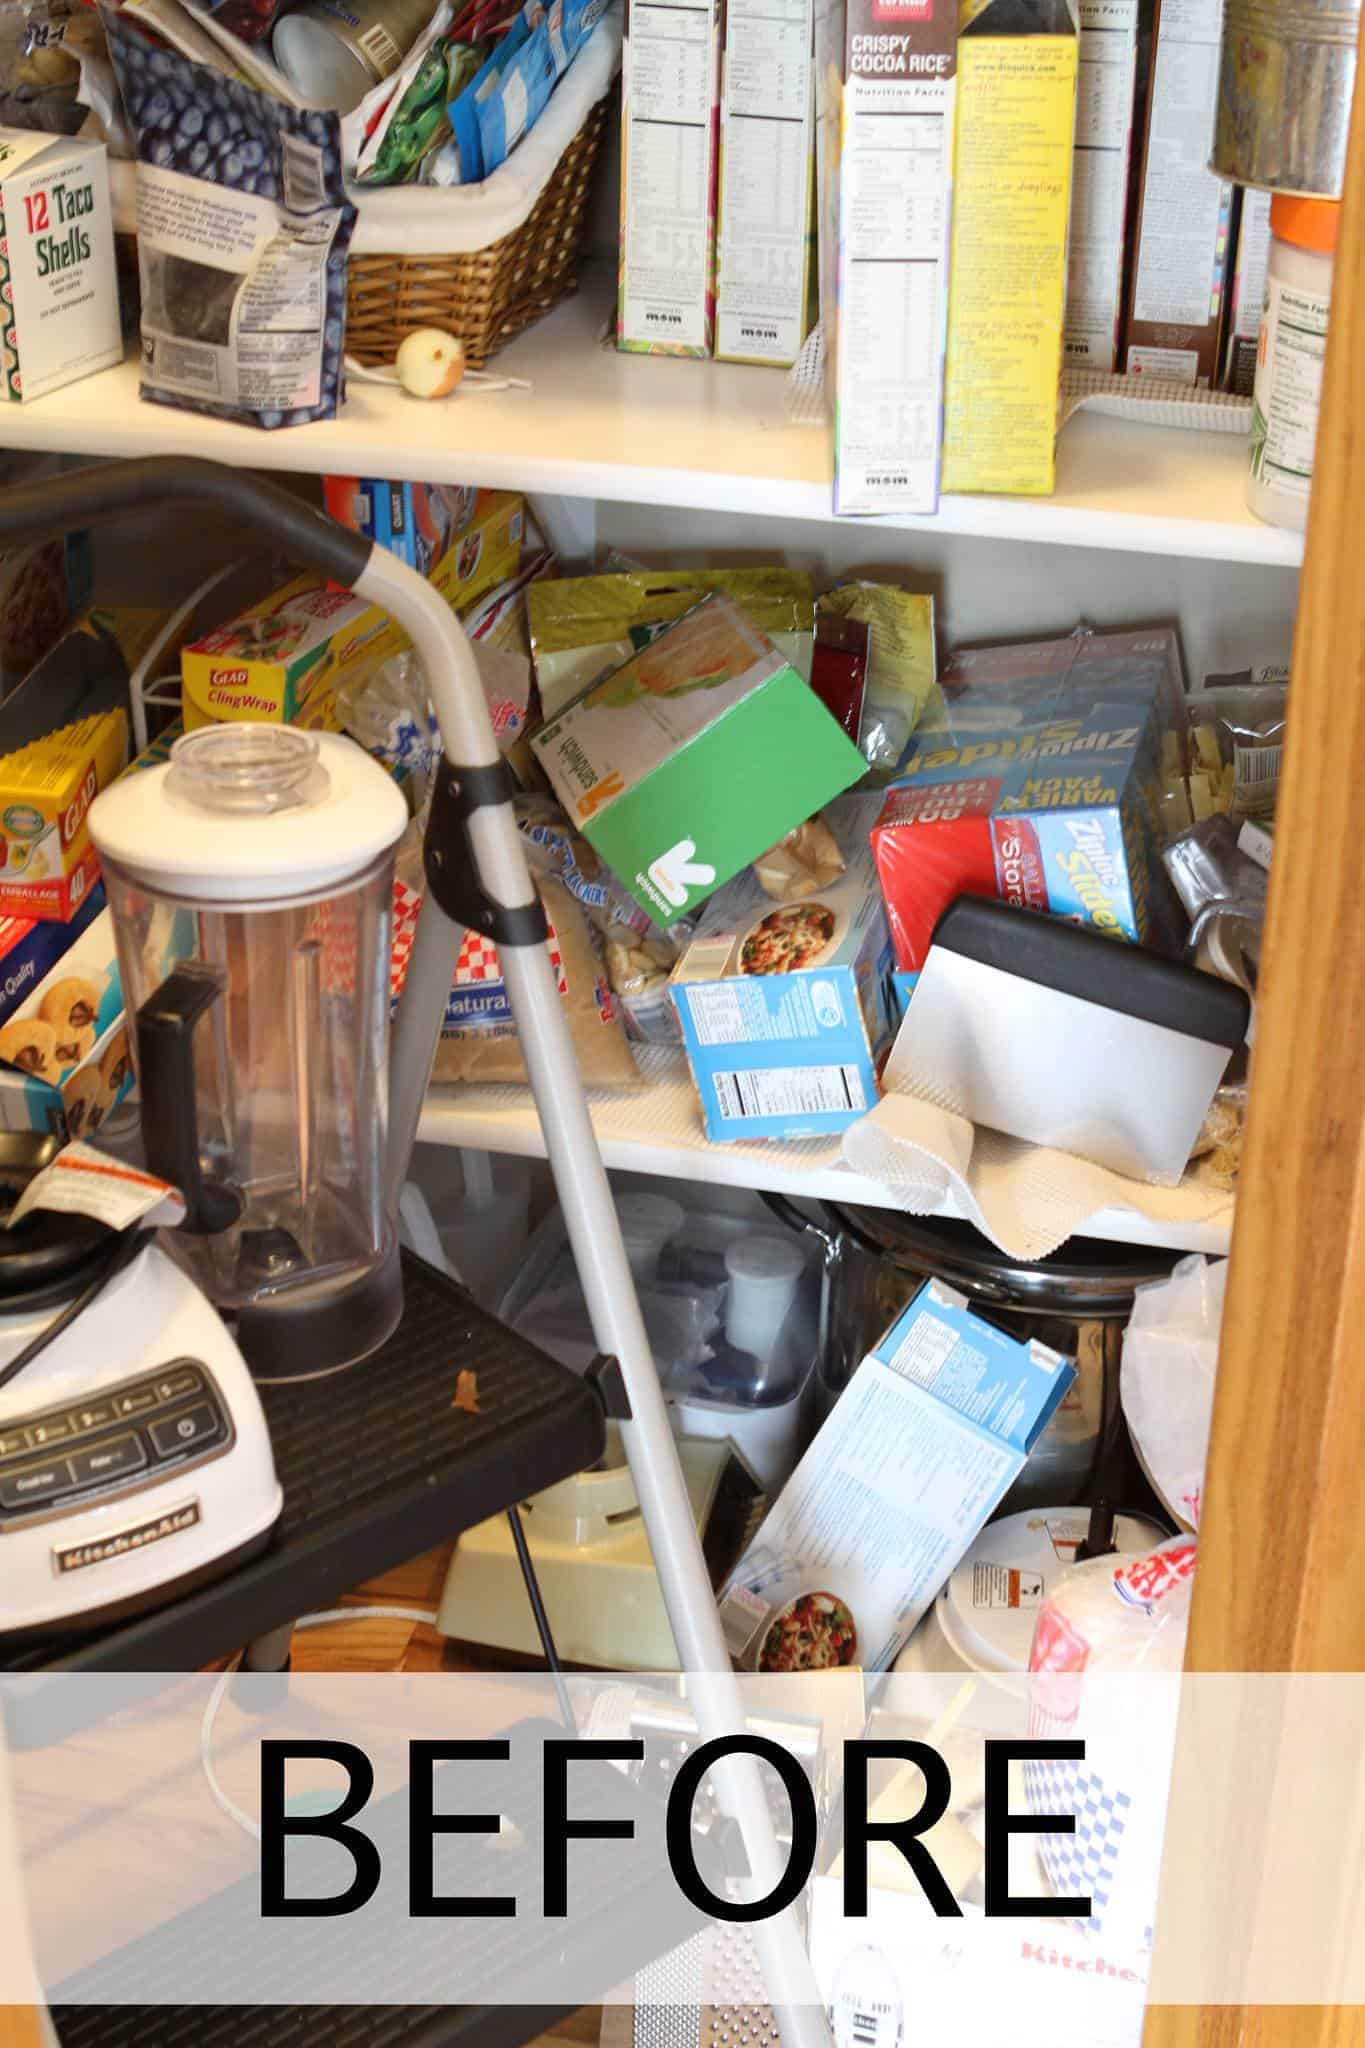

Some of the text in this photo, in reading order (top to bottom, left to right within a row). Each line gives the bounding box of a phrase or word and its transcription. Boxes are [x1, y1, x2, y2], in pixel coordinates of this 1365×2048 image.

[851, 34, 911, 53] CRISPY
[851, 54, 906, 73] COCOA
[22, 190, 50, 235] 12
[52, 183, 94, 224] Taco
[36, 224, 92, 277] Shells
[213, 671, 247, 685] GLAD
[64, 769, 96, 842] GLAD
[999, 788, 1117, 811] VARIETY
[1001, 836, 1024, 907] Stora
[5, 959, 36, 997] Quality
[447, 994, 511, 1017] atura
[63, 1508, 196, 1568] KitchenAid
[1021, 1941, 1146, 1984] Kitche
